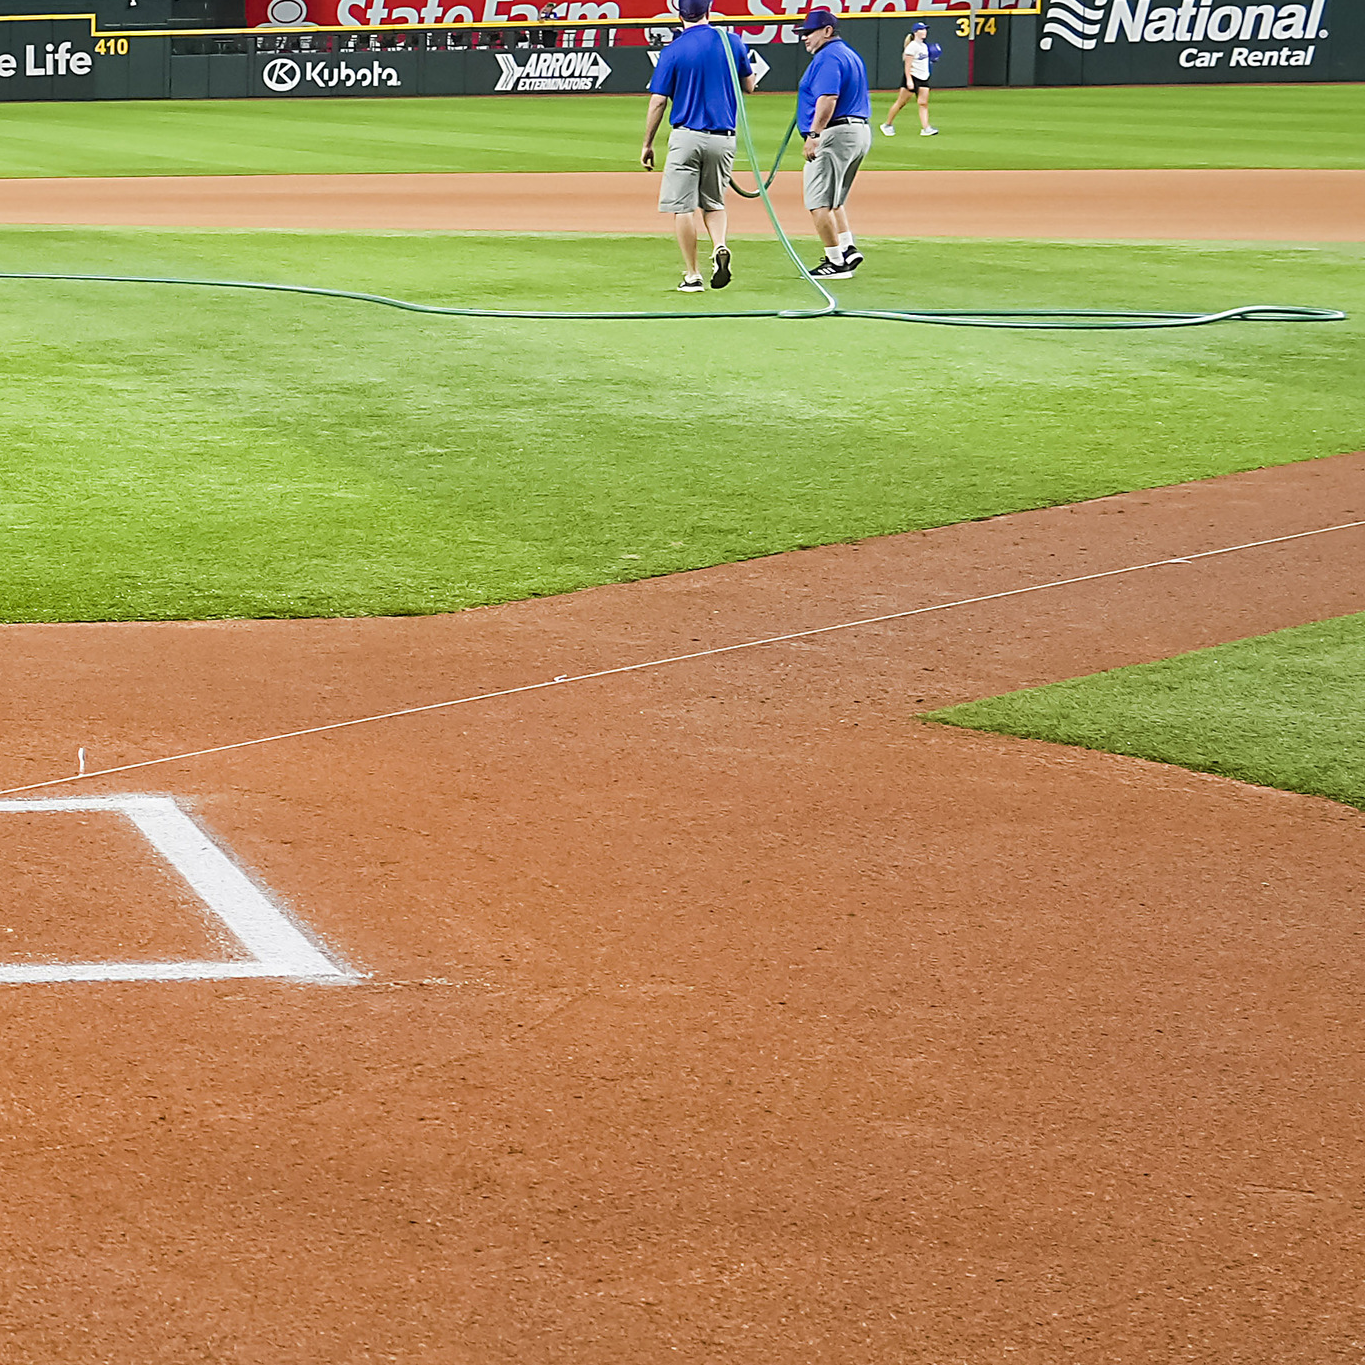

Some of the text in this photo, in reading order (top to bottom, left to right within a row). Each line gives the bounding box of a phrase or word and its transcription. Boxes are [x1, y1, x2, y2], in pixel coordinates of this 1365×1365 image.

[26, 41, 92, 76] Life
[94, 39, 128, 55] 410
[1179, 45, 1315, 67] Car Rental
[305, 60, 399, 87] Kubota
[523, 52, 596, 76] ARROW
[518, 77, 593, 91] EXTERMINATORS
